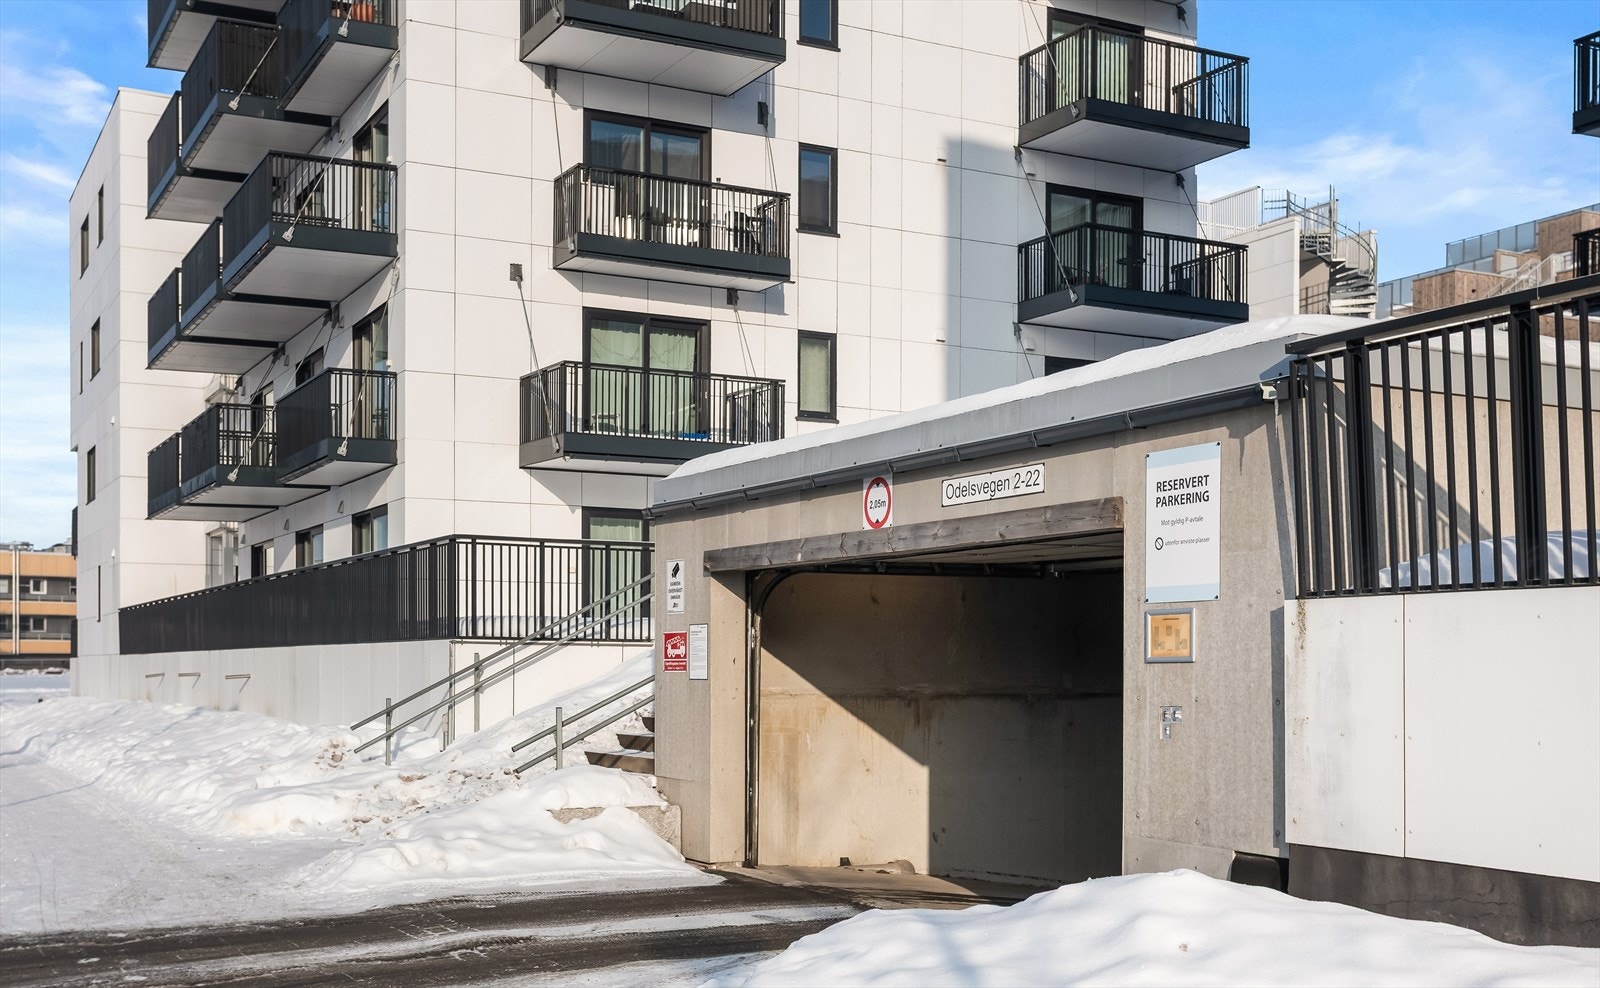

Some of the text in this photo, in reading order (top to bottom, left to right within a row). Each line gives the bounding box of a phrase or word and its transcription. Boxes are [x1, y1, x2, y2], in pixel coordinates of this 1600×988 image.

[945, 469, 1041, 499] Odelsvegen 2-22
[1156, 474, 1210, 492] RESERVERT
[869, 499, 887, 509] 2,05m
[1155, 490, 1210, 508] PARKERING
